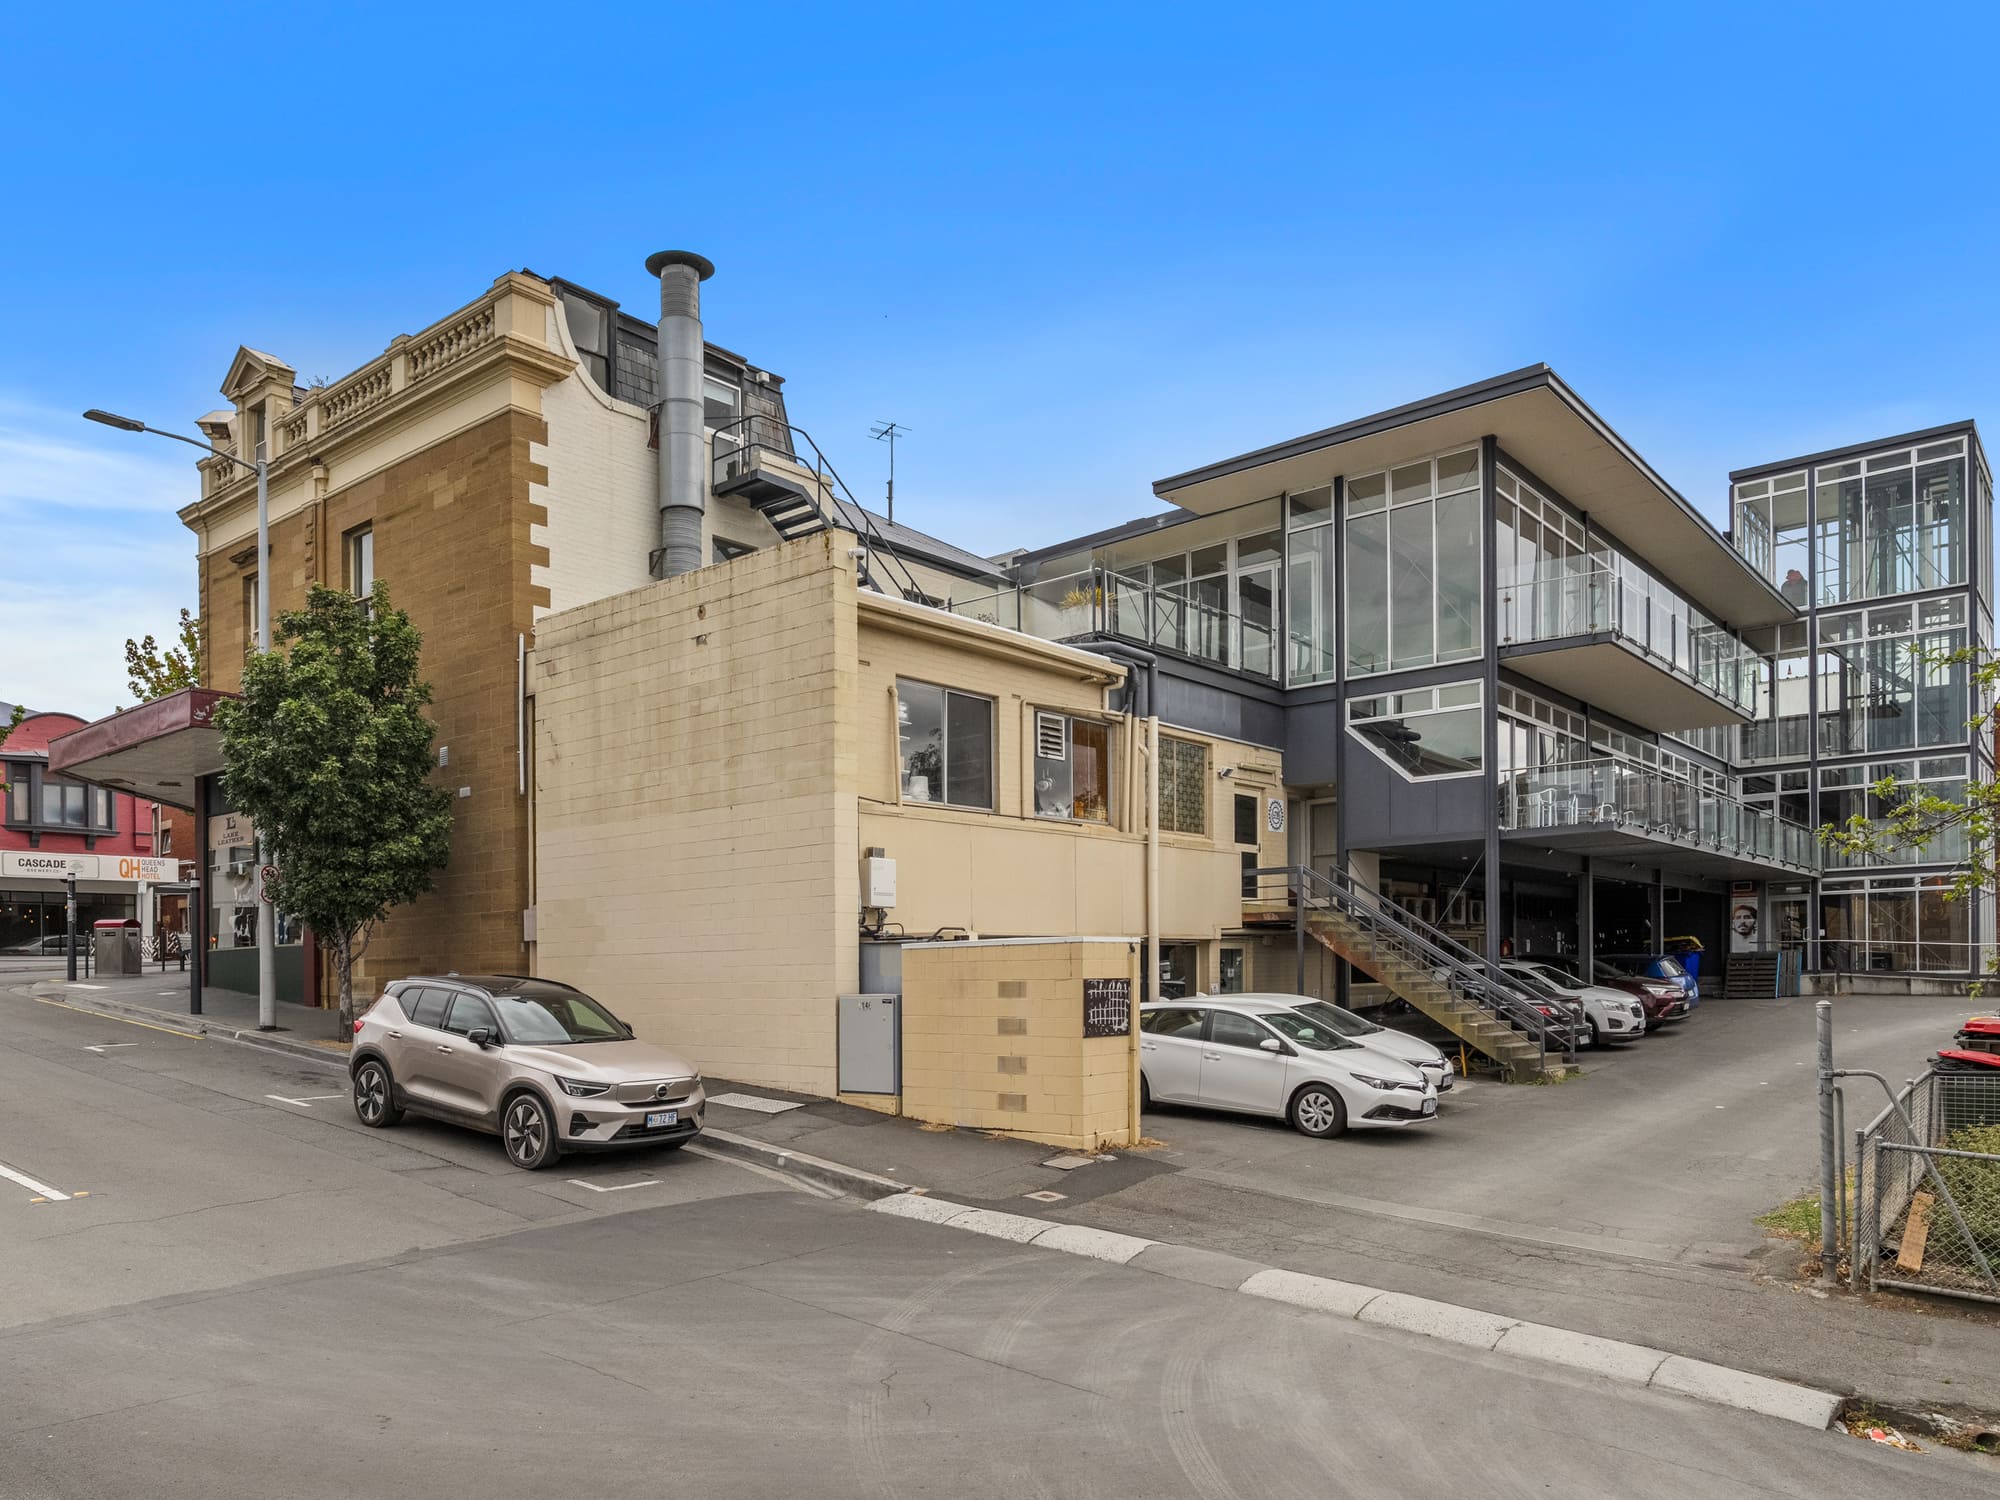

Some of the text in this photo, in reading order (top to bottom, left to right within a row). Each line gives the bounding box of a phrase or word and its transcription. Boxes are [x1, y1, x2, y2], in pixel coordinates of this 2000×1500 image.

[18, 858, 66, 868] CASCADE
[141, 859, 166, 867] QUEENS
[119, 858, 141, 879] QH
